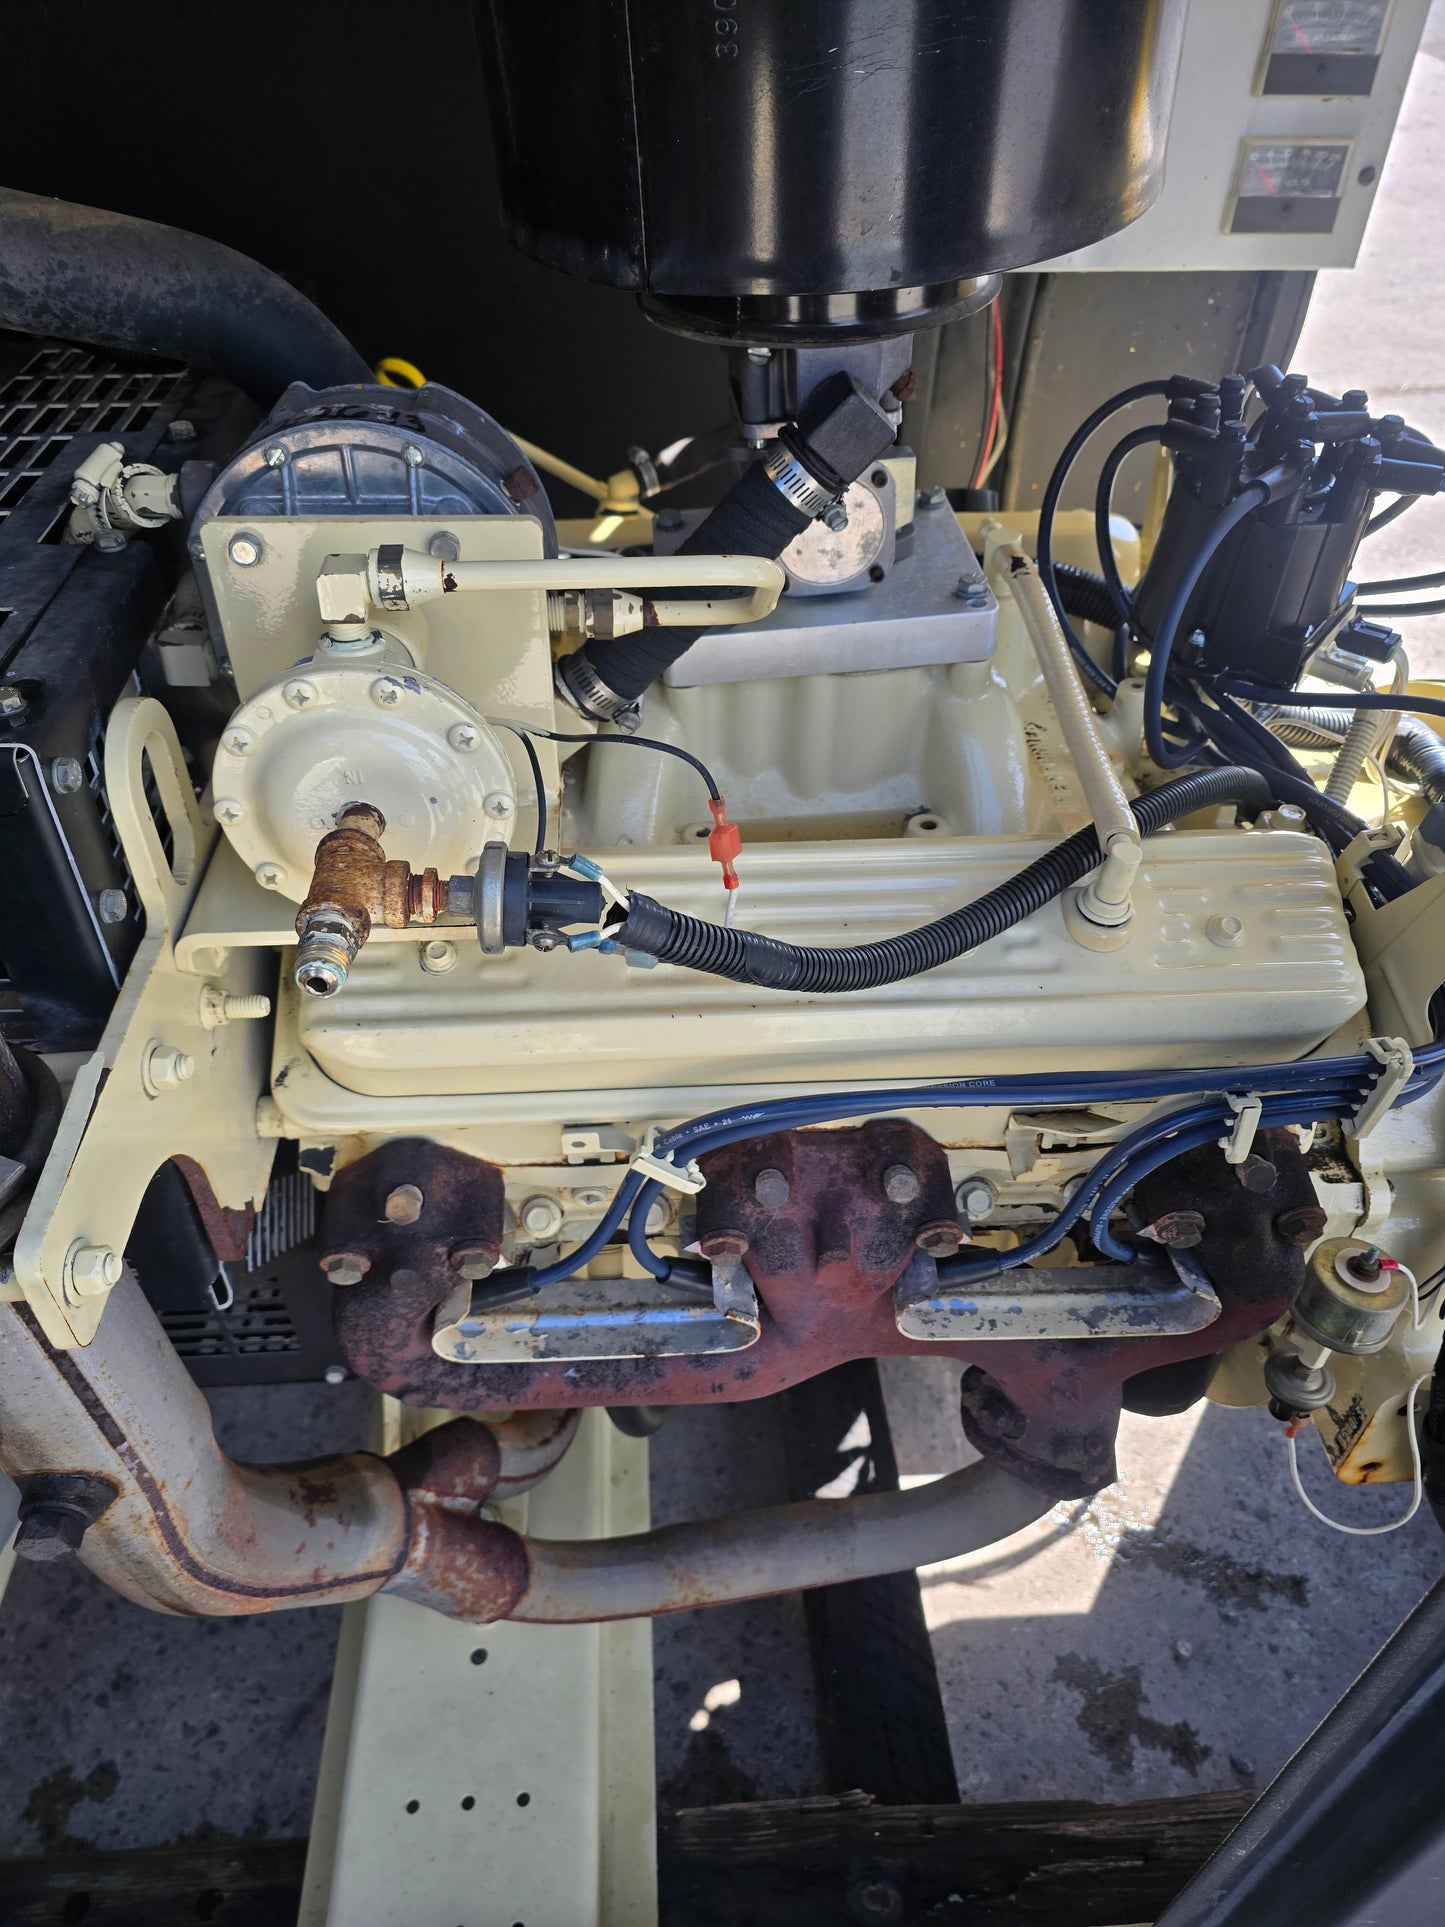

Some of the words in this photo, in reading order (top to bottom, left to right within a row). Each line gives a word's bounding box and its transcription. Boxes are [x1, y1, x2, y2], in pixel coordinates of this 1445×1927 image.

[968, 1080, 996, 1088] CORE
[663, 1132, 683, 1145] Cable
[693, 1122, 711, 1134] SAE
[721, 1117, 732, 1126] 21
